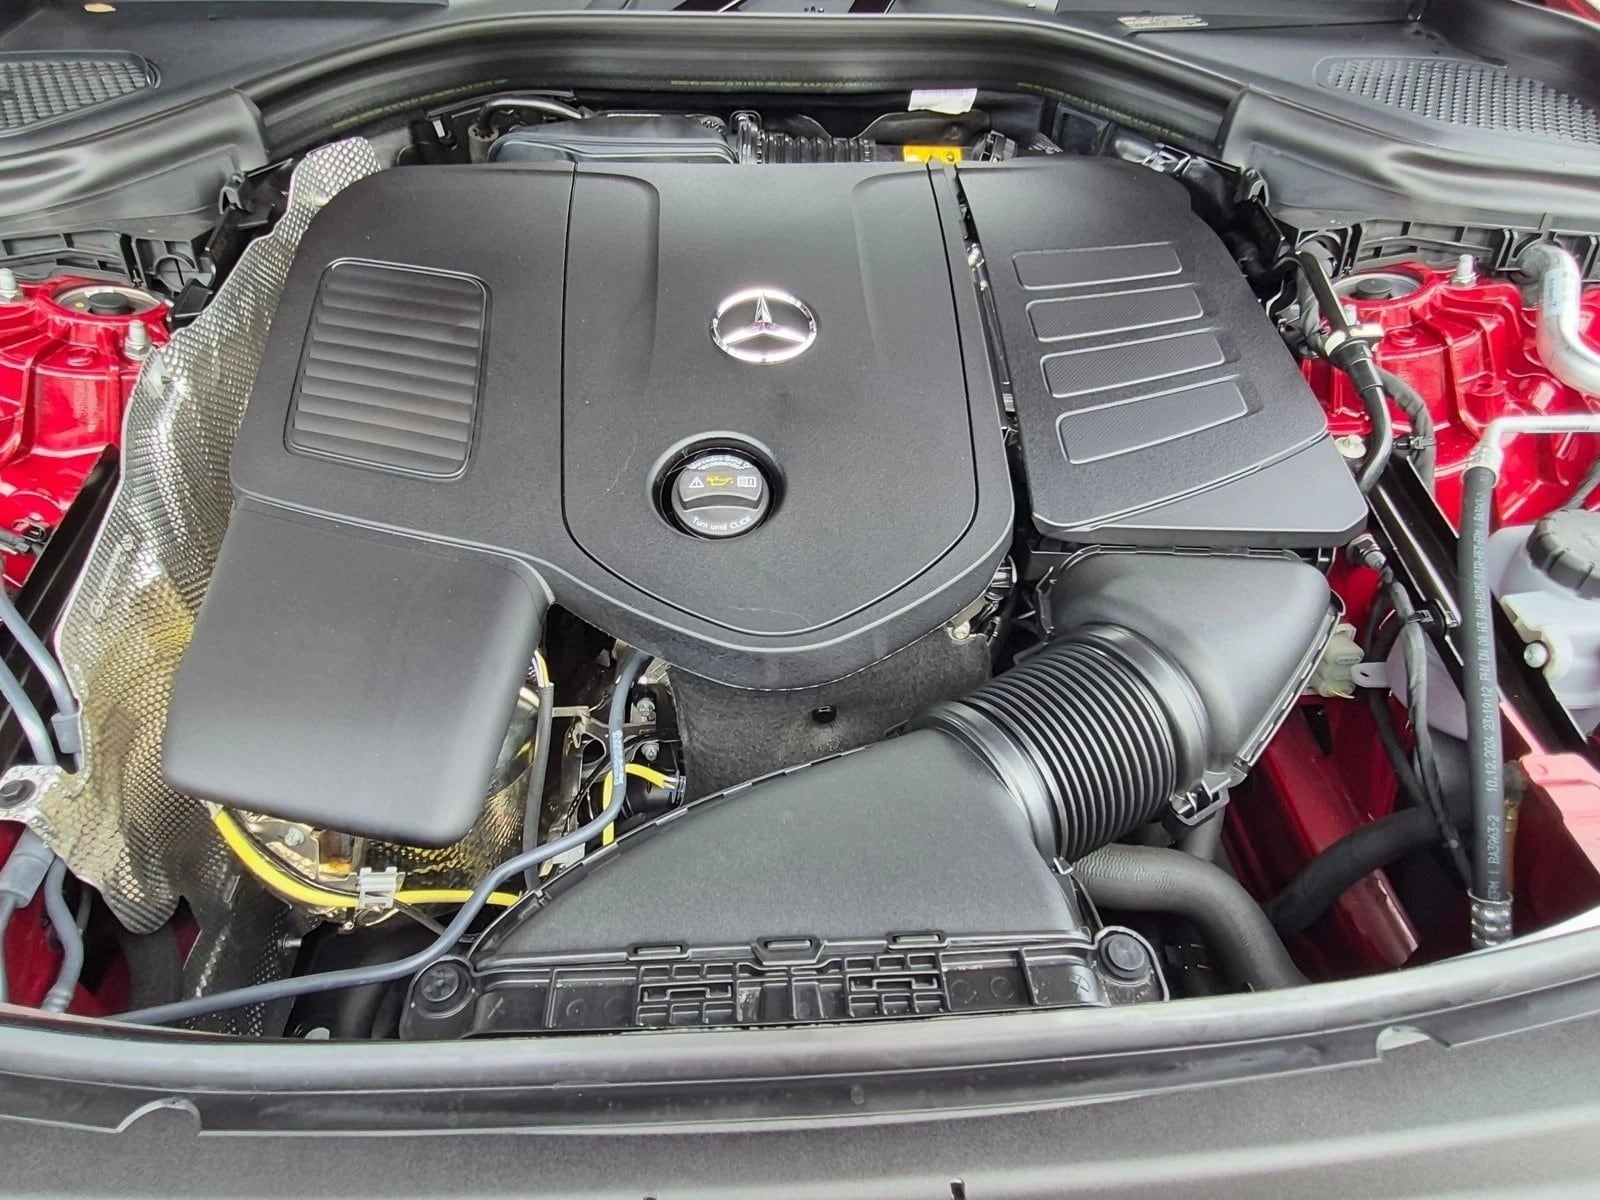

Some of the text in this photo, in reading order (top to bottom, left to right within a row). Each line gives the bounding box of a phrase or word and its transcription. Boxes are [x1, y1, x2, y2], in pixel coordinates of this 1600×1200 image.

[692, 515, 752, 531] Turn until CLICK
[1481, 687, 1494, 731] 23:19:12
[1487, 815, 1500, 865] BA3963-2
